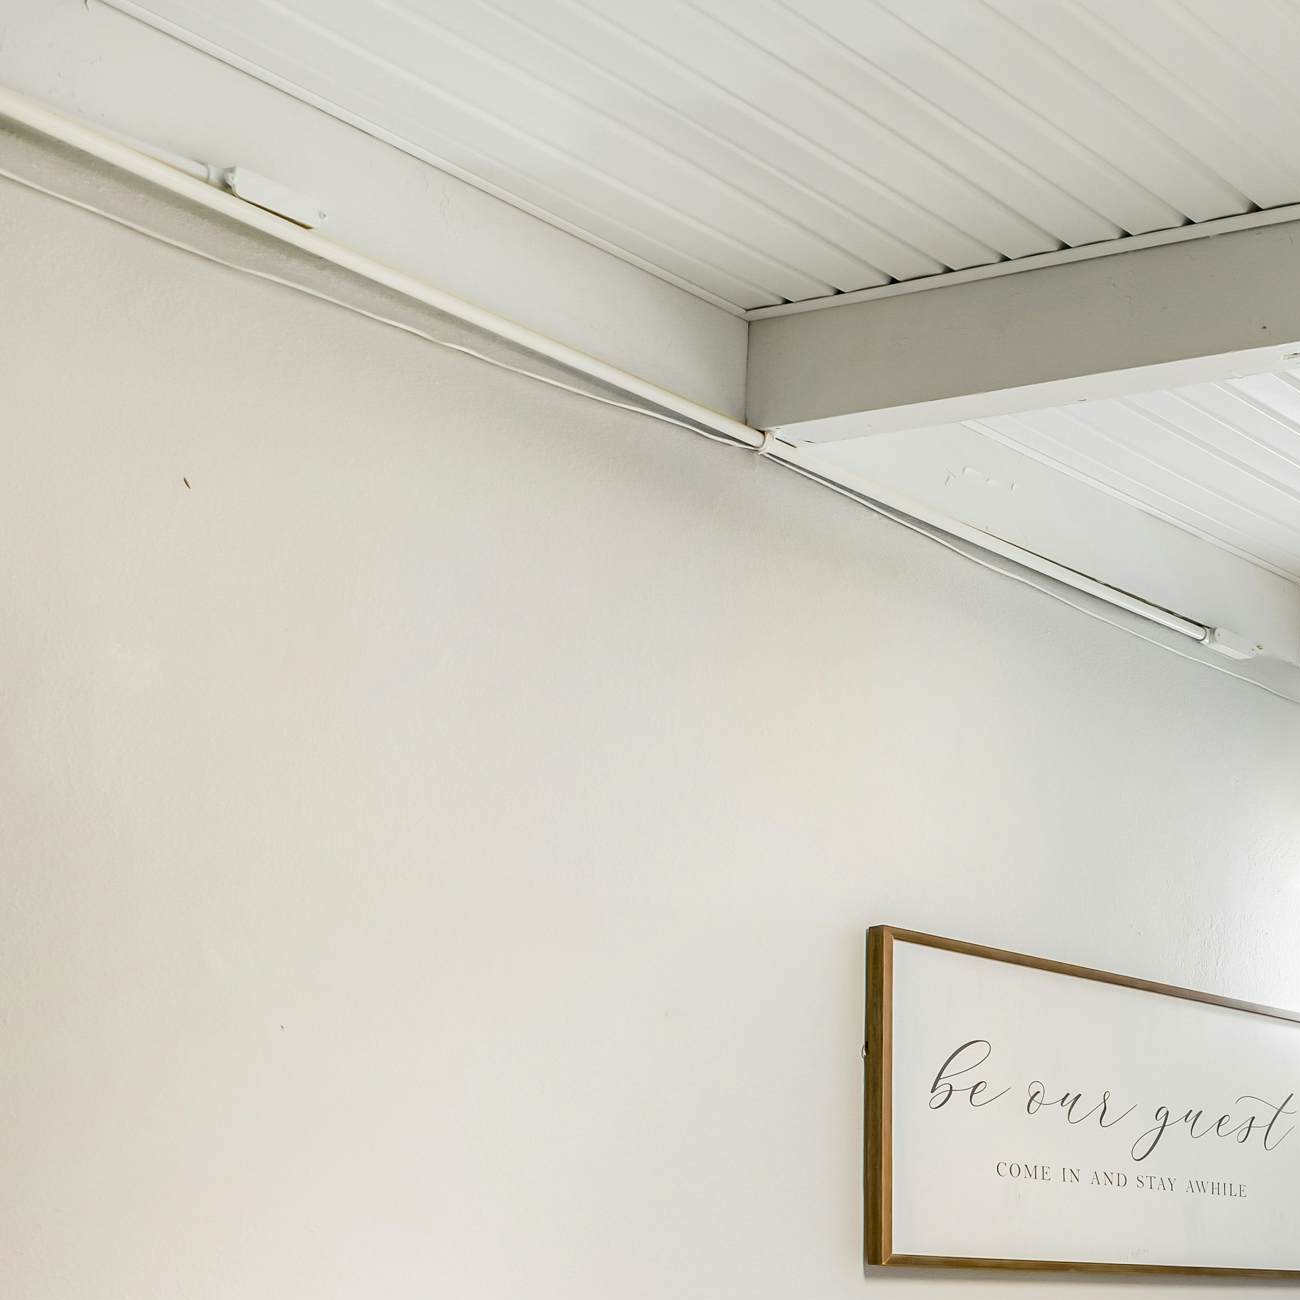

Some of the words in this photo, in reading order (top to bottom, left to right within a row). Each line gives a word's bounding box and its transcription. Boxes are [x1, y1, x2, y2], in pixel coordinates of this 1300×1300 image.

[928, 1039, 1011, 1110] be
[1026, 1080, 1138, 1129] our
[1131, 1093, 1297, 1161] guest
[996, 1161, 1051, 1182] COME
[1062, 1167, 1081, 1183] IN
[1091, 1170, 1128, 1188] AND
[1136, 1174, 1177, 1192] STAY
[1185, 1179, 1248, 1198] AWHILE
